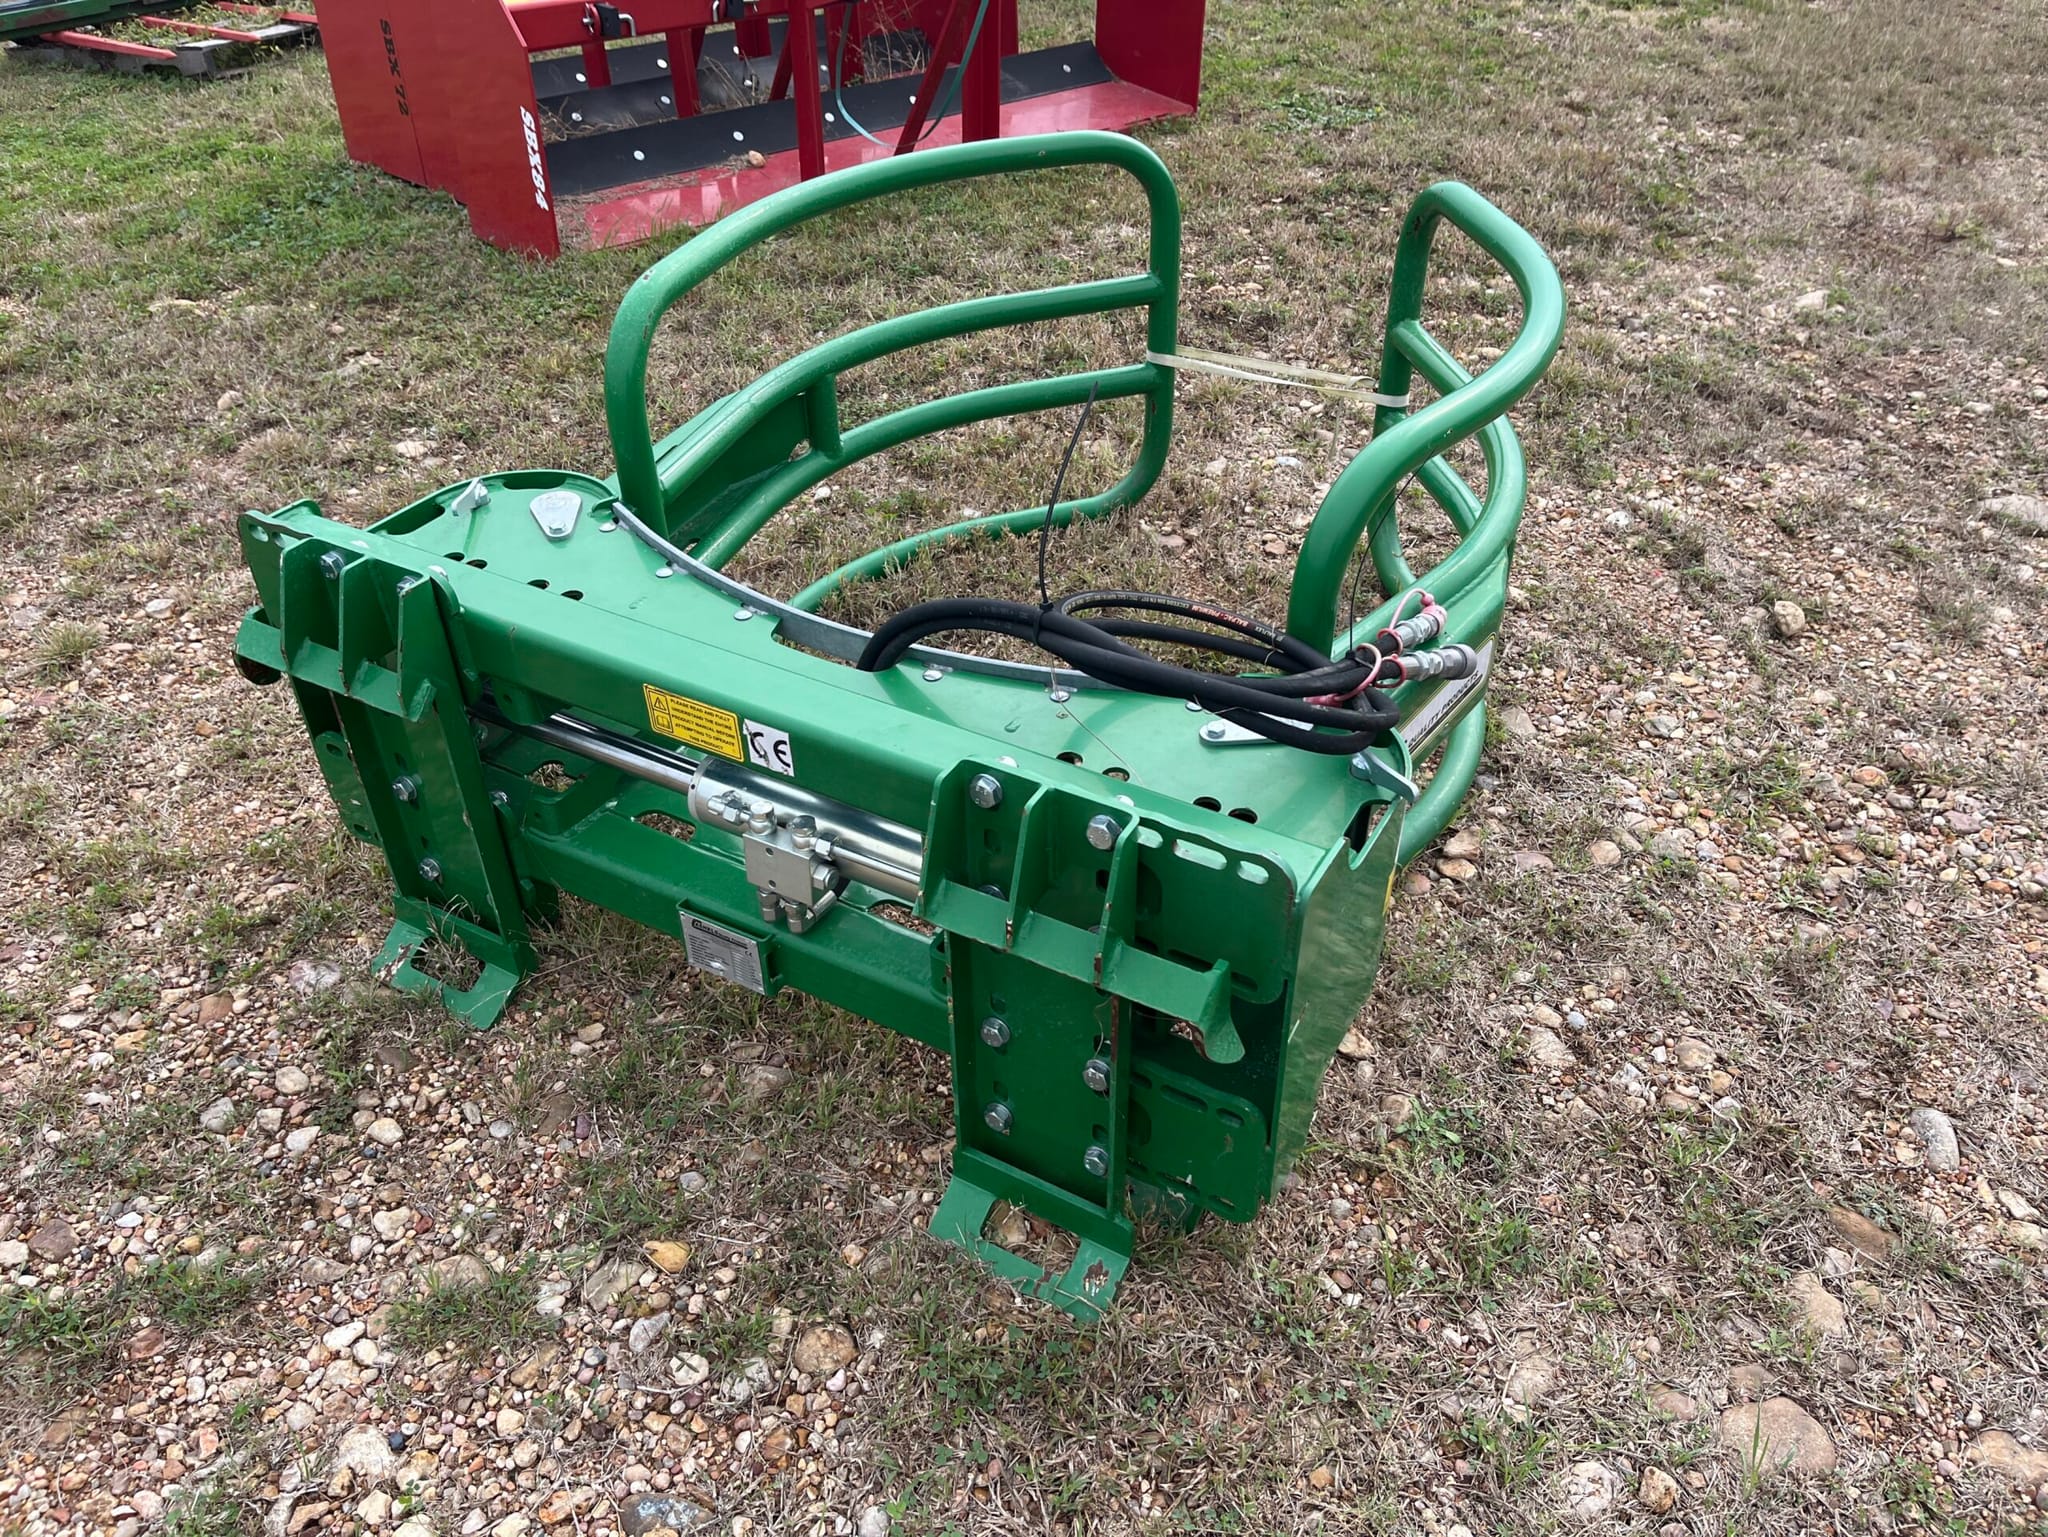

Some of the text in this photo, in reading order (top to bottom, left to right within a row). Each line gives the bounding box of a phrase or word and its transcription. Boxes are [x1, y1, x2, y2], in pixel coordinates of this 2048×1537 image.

[380, 18, 409, 116] SBX 72
[519, 105, 549, 211] SBX84
[1440, 670, 1479, 714] PRODUCTS
[670, 698, 730, 722] PLEASE READ AND FULLY
[671, 706, 704, 721] UNDERSTAND
[714, 720, 732, 730] ENTIRE
[671, 713, 735, 739] PRODUCT MANUAL BEFORE
[675, 722, 705, 736] ATTEMPTING
[712, 735, 735, 746] OPERATE
[700, 739, 723, 750] PRODUCT
[750, 731, 791, 769] CE
